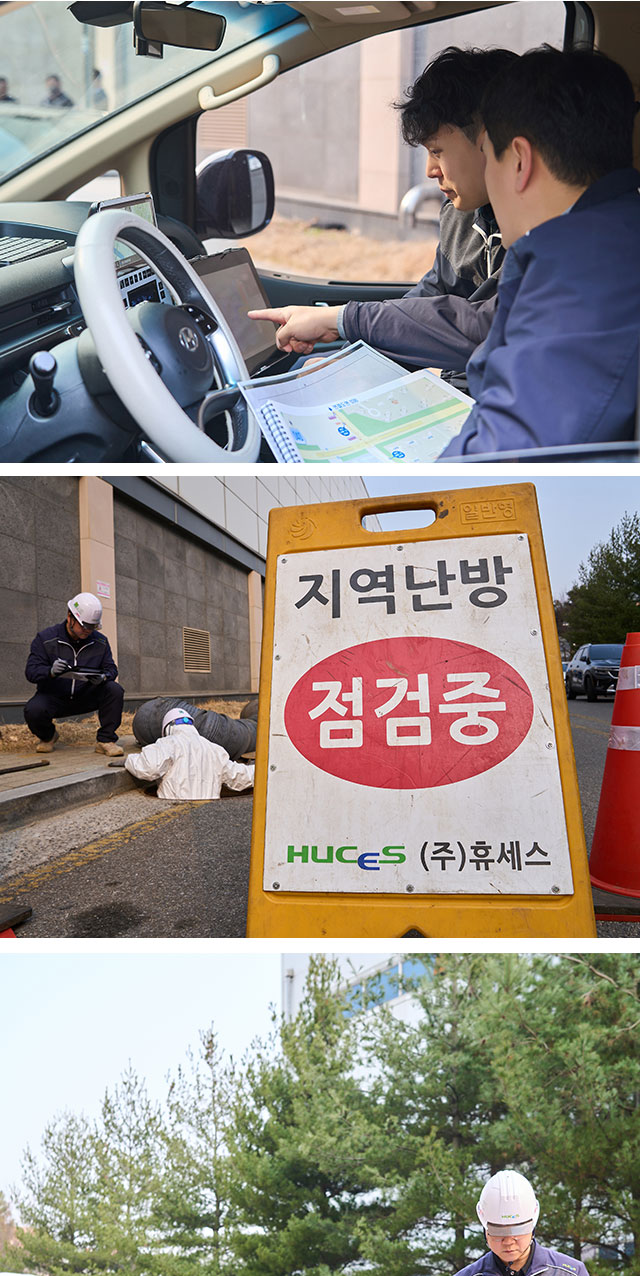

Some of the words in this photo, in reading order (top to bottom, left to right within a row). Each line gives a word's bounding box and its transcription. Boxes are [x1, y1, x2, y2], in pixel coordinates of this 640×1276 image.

[294, 555, 513, 619] 지역난방
[307, 671, 507, 750] 점검중
[420, 840, 551, 872] (주)휴세스
